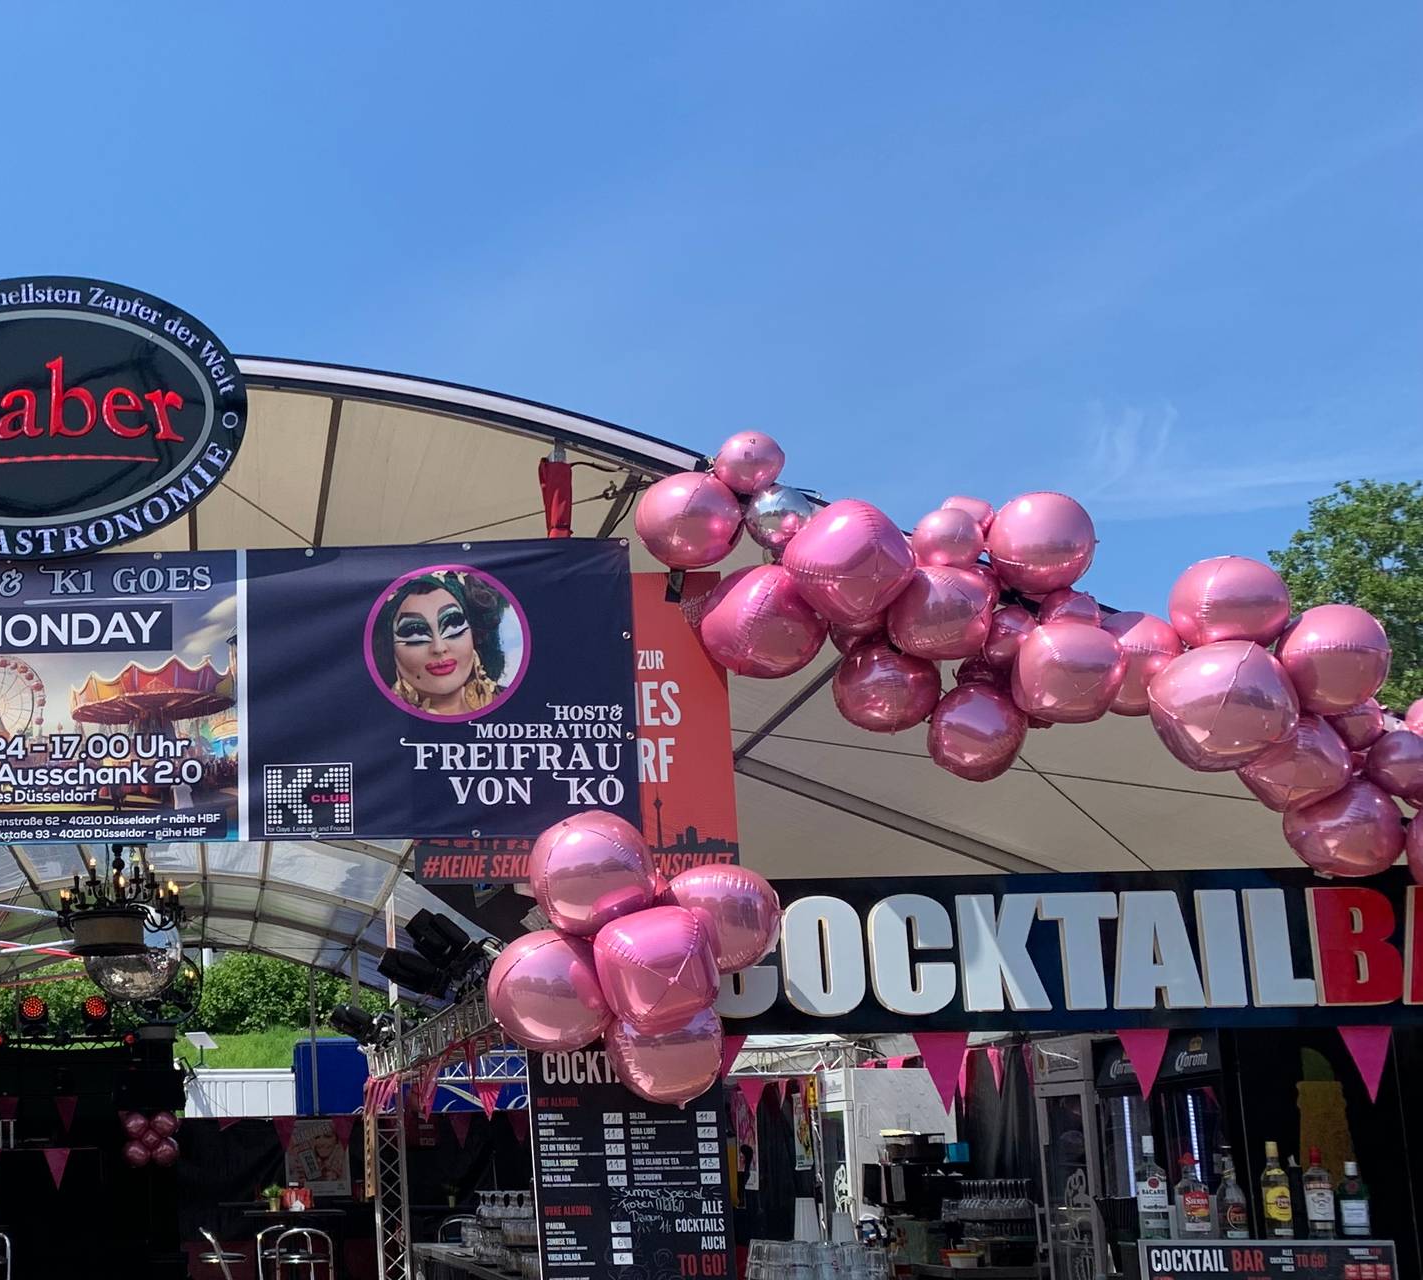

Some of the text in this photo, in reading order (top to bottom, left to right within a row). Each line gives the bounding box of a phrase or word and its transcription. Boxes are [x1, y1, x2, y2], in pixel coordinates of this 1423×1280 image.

[87, 286, 162, 326] Zapfer
[164, 316, 200, 348] der
[199, 339, 236, 397] Welt
[38, 565, 95, 594] K1
[112, 565, 212, 594] GOES
[637, 650, 665, 670] ZUR
[546, 703, 623, 721] HOST&
[468, 720, 622, 739] MODERATION
[50, 734, 129, 759] 17.00
[136, 733, 191, 758] Uhr
[400, 738, 622, 771] FREIFRAU
[154, 759, 203, 785] 2.0
[14, 789, 97, 803] Düsseldorf
[267, 767, 349, 825] K1 CLUB
[448, 771, 625, 806] VON KÖ
[45, 816, 60, 826] 62
[68, 815, 103, 826] 40210
[104, 813, 161, 825] Düsseldorf
[169, 814, 196, 824] nähe
[197, 813, 221, 823] HBF
[35, 829, 50, 839] 93
[59, 828, 92, 839] 40210
[94, 828, 146, 839] Düsseldor
[183, 827, 207, 838] HBF
[422, 853, 531, 878] #KEINE SEKU
[541, 1050, 620, 1085] COCKT
[1175, 1051, 1209, 1072] Corona
[701, 1200, 723, 1214] ALLE
[675, 1218, 725, 1232] COCKTAILS
[701, 1235, 726, 1250] AUCH
[677, 1253, 727, 1276] TO GO!
[1150, 1248, 1266, 1272] COCKTAIL BAR
[1296, 1254, 1311, 1268] TO
